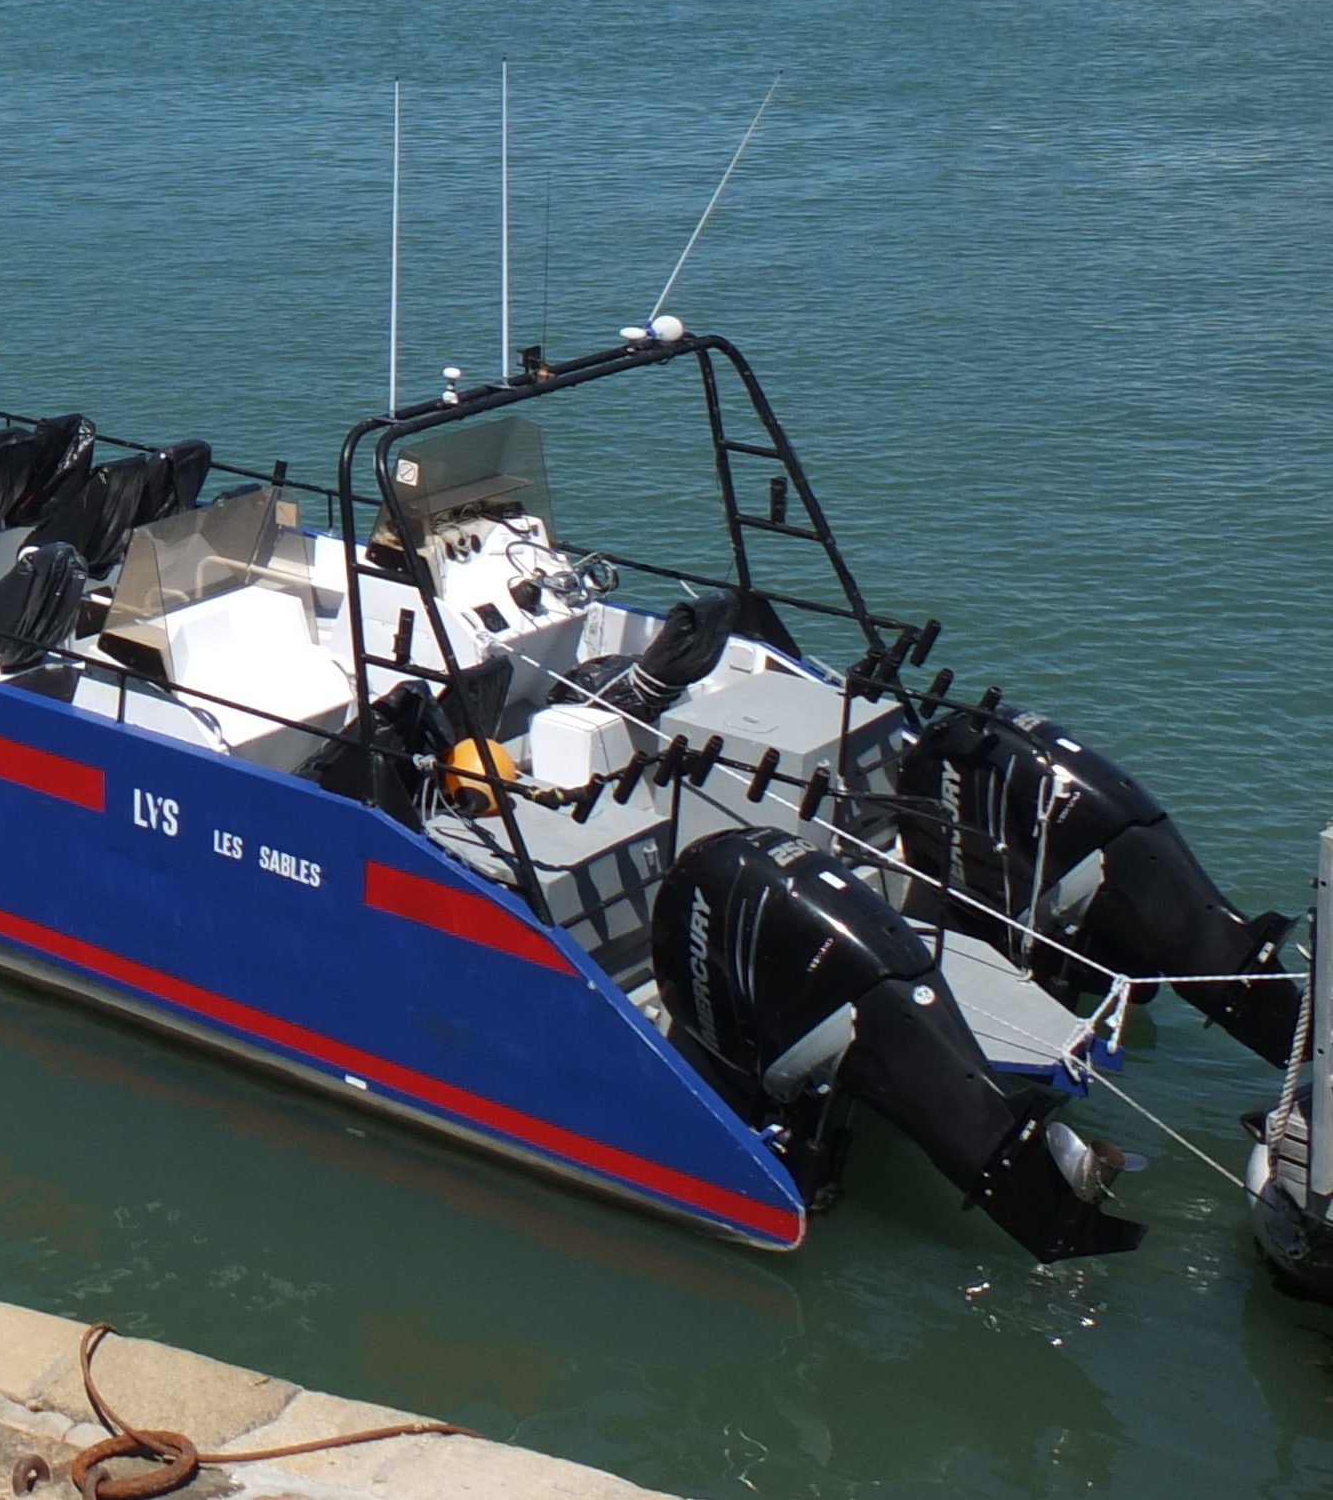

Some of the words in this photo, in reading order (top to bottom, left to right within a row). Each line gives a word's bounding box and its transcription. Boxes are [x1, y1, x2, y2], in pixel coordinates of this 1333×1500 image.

[133, 787, 180, 837] LYS
[213, 828, 244, 860] LES
[259, 844, 322, 888] SABLES
[767, 838, 818, 868] 250
[690, 885, 720, 1051] MERCURY
